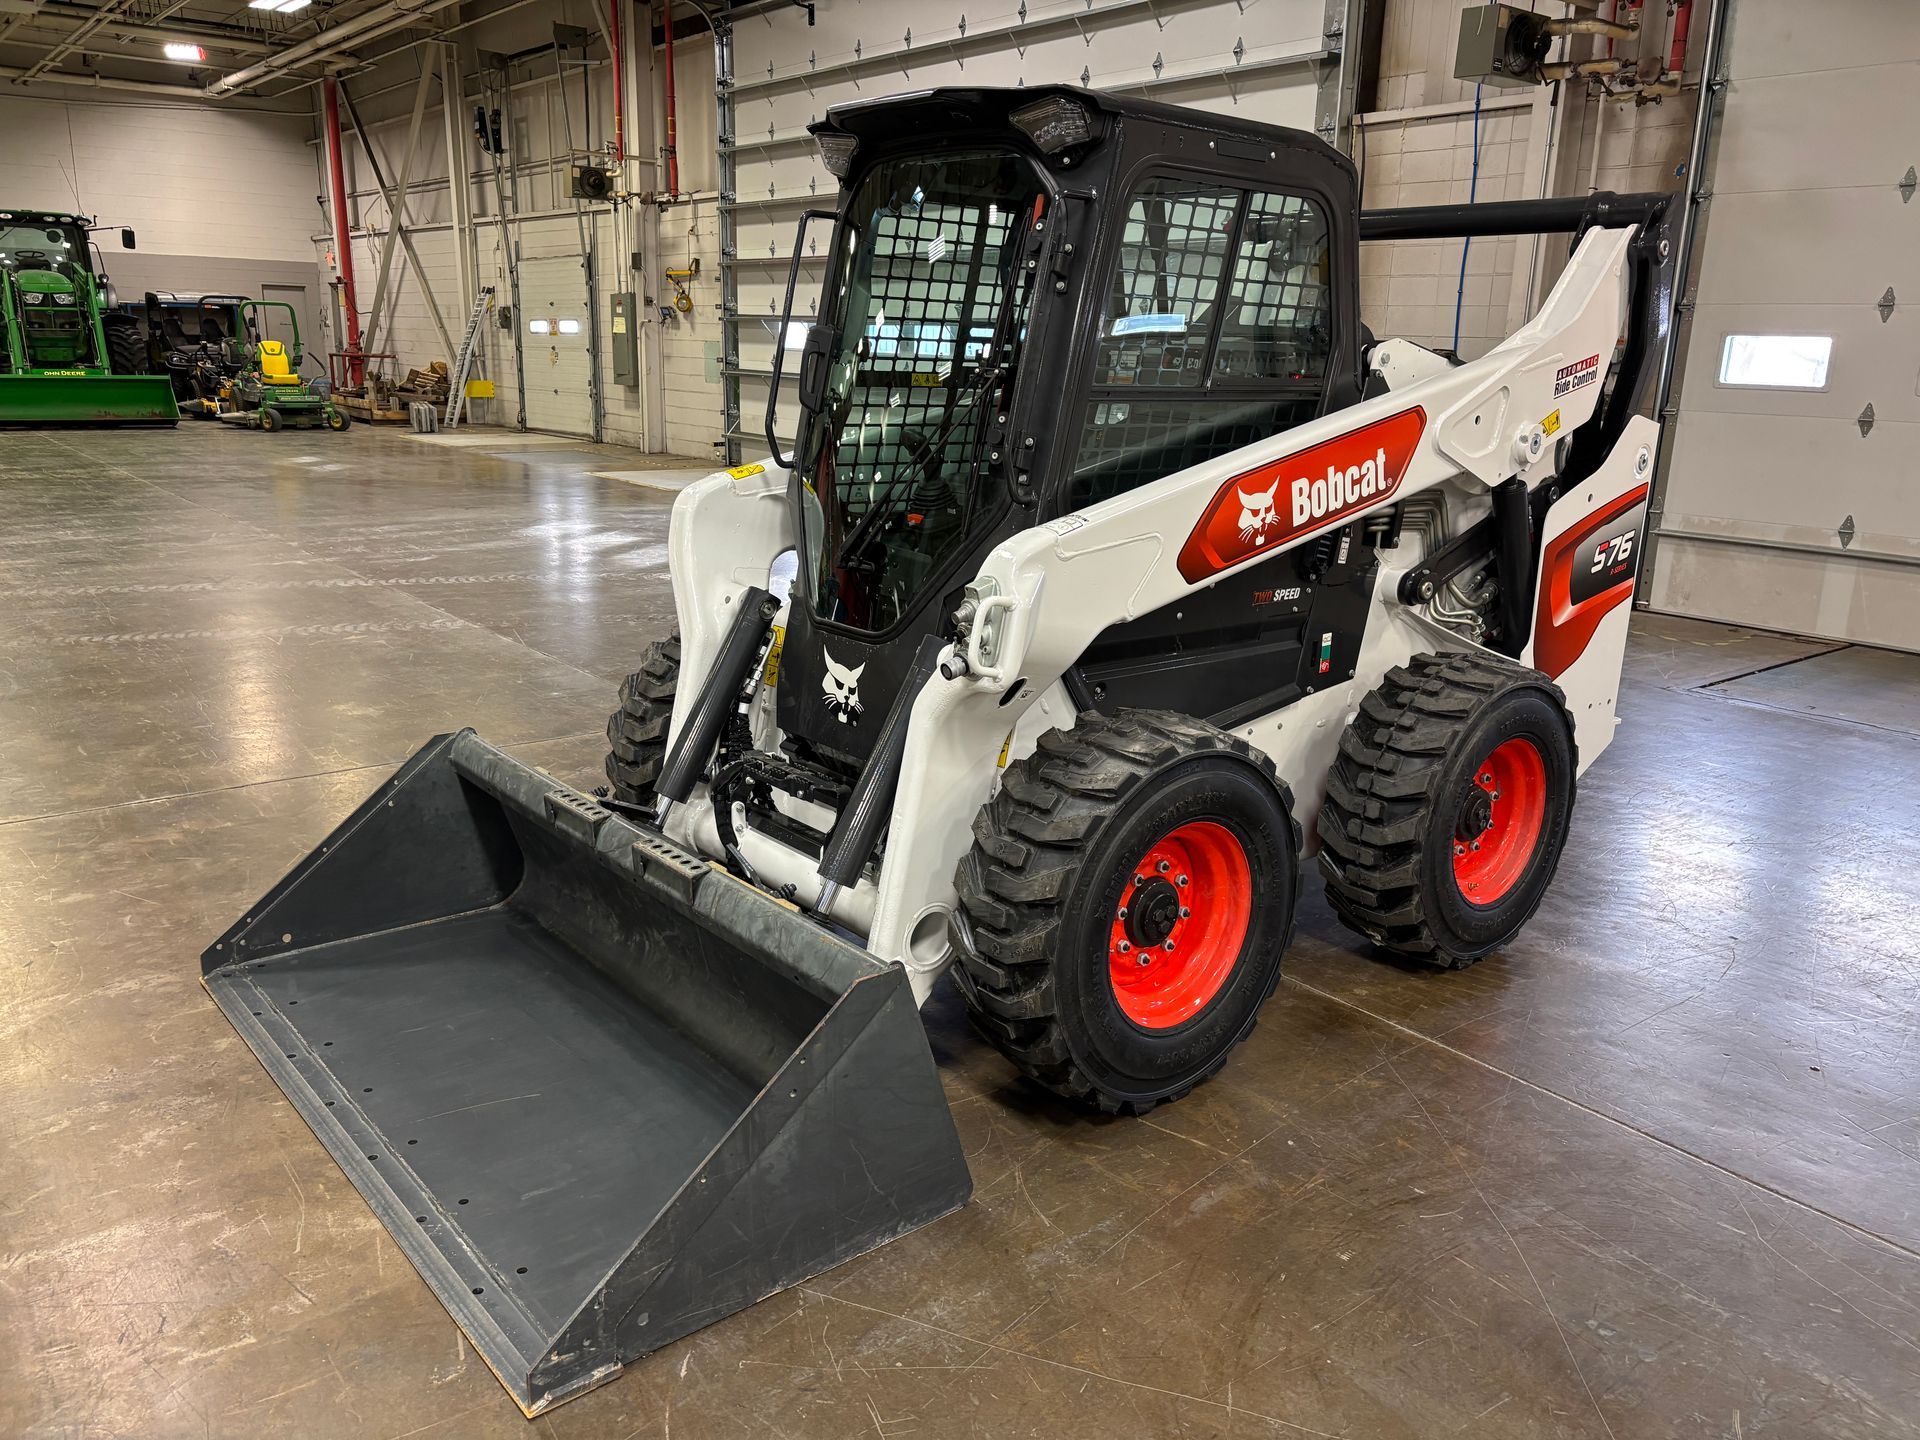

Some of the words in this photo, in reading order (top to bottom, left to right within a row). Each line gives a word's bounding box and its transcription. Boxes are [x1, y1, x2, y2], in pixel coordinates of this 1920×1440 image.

[1554, 379, 1571, 397] Ride
[1572, 366, 1598, 389] Control
[1557, 355, 1599, 381] AUTOMATIC
[1291, 447, 1386, 528] Bobcat
[1591, 529, 1636, 574] S76
[1253, 591, 1273, 604] TWO
[1273, 587, 1301, 602] SPEED
